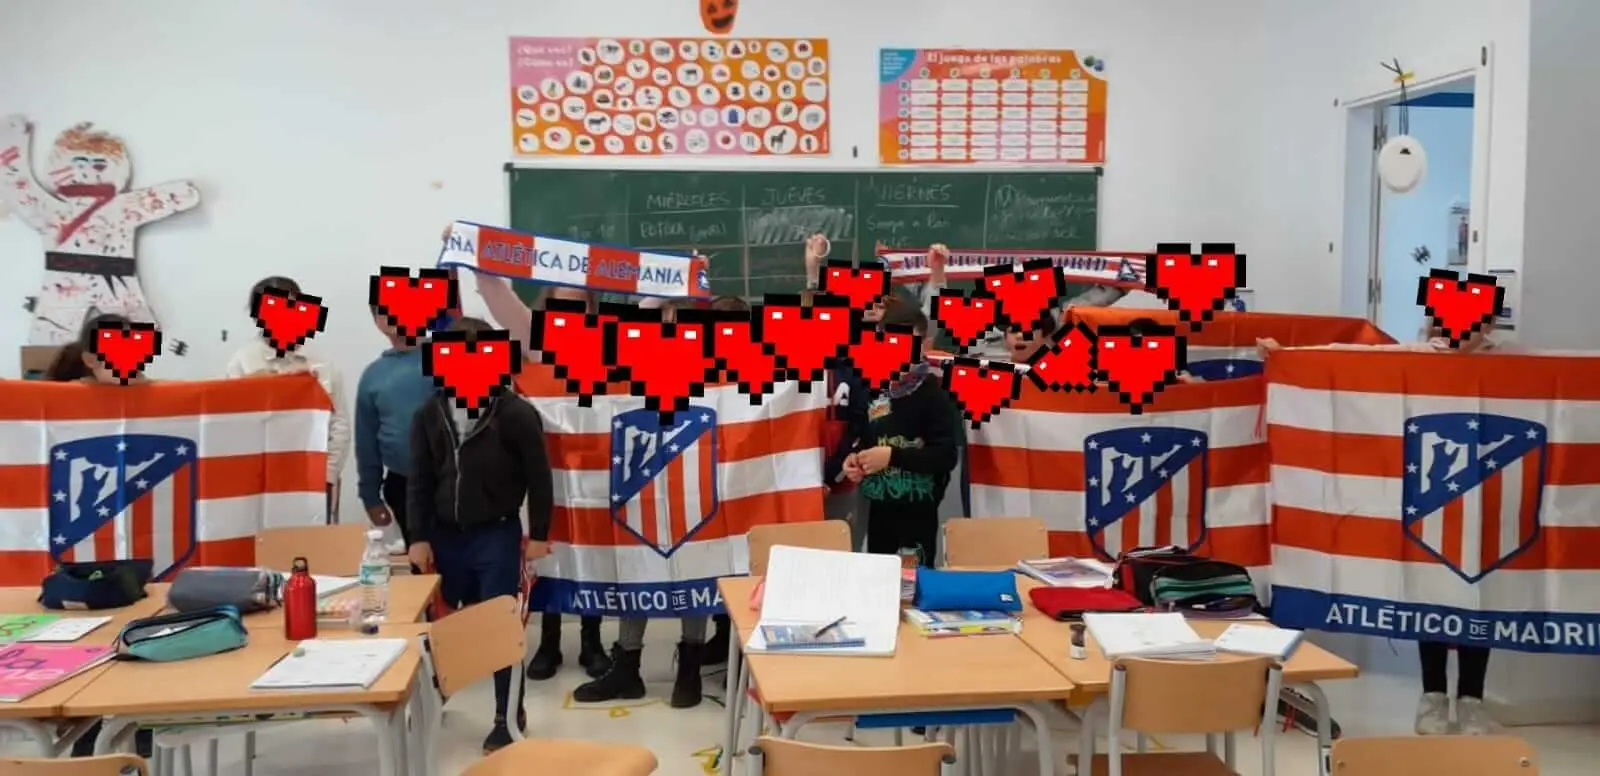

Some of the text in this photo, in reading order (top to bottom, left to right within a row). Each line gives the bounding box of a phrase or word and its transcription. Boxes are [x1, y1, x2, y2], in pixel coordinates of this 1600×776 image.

[568, 254, 589, 274] DE
[595, 258, 684, 286] ALEMANIA
[571, 587, 668, 612] ATLÉTICO
[1325, 602, 1463, 637] ATLÉTICO
[1494, 621, 1600, 646] MADRI
